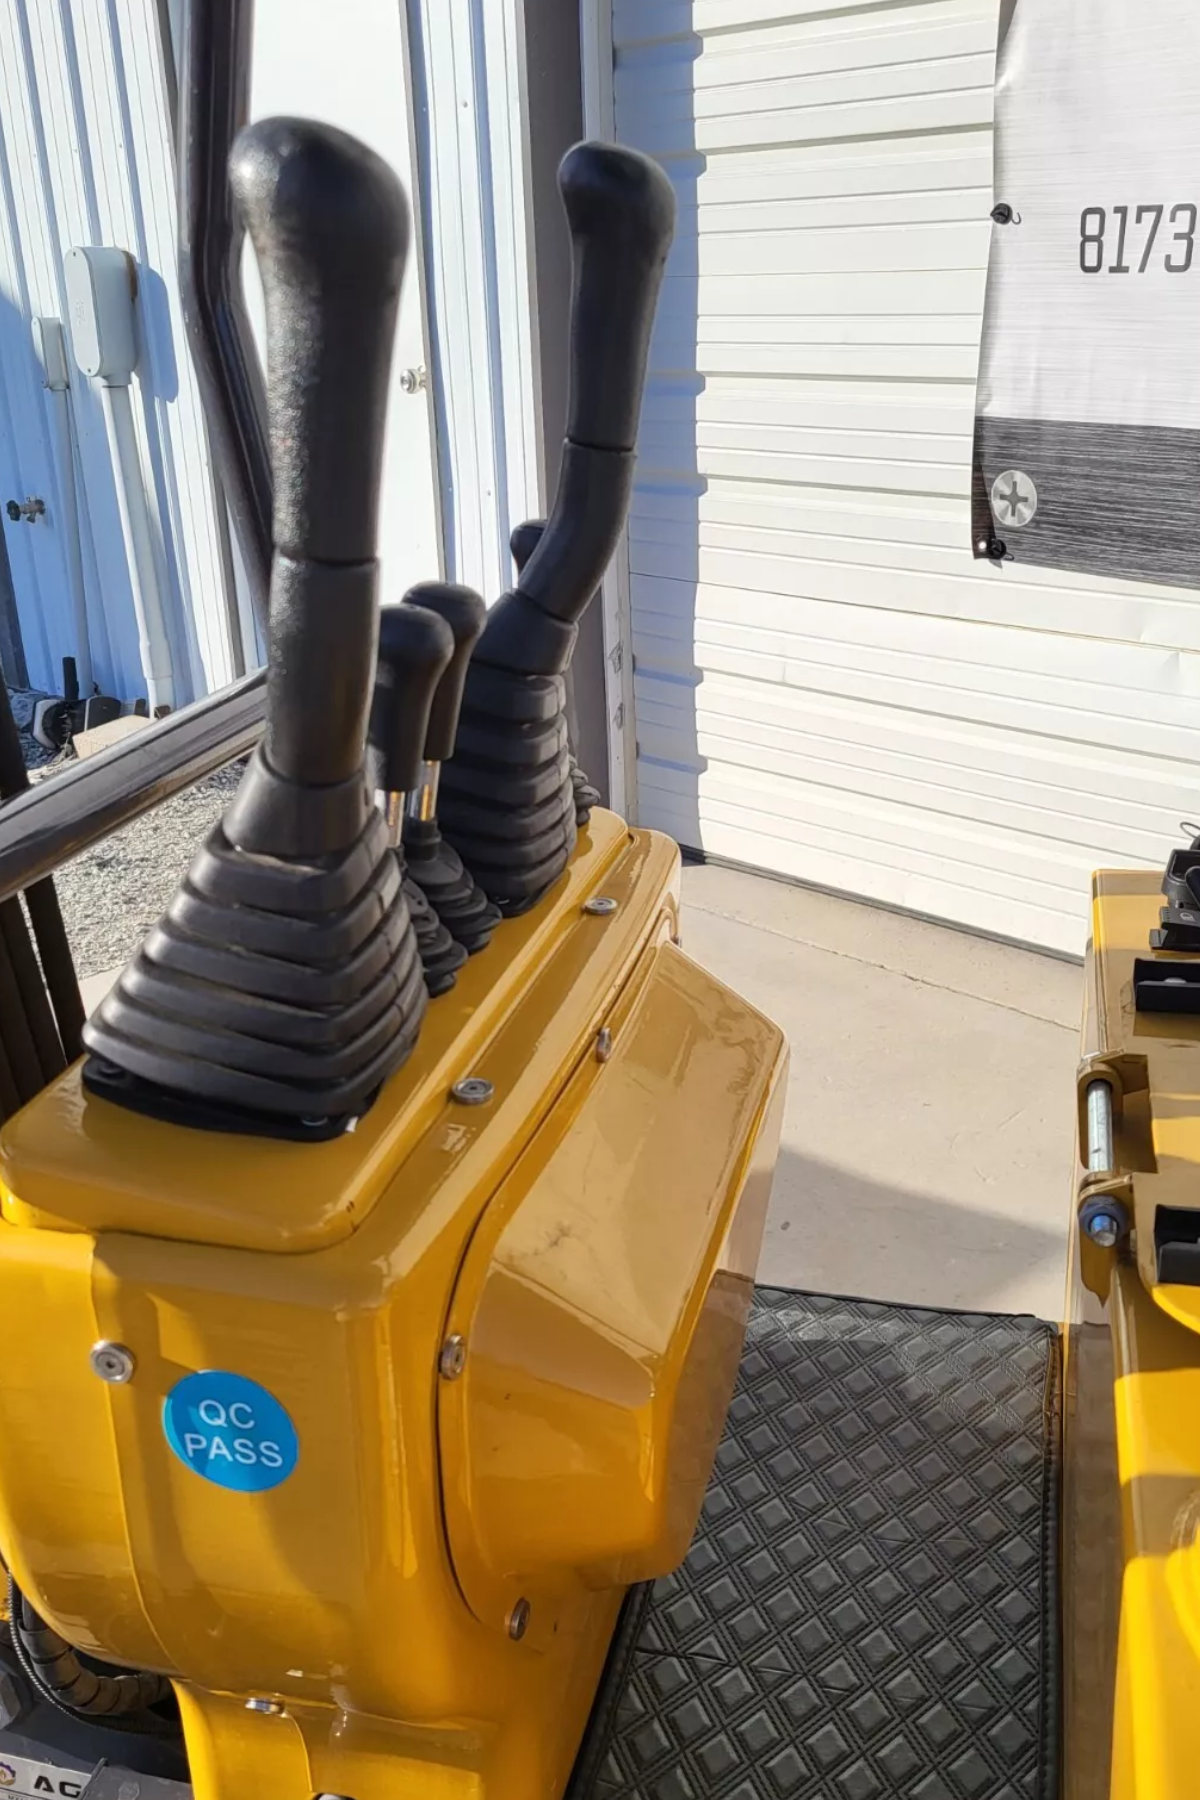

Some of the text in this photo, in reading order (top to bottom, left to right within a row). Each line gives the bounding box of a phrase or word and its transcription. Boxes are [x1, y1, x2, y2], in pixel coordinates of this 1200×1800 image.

[1079, 203, 1197, 273] 8173
[199, 1399, 255, 1429] QC
[184, 1433, 283, 1467] PASS
